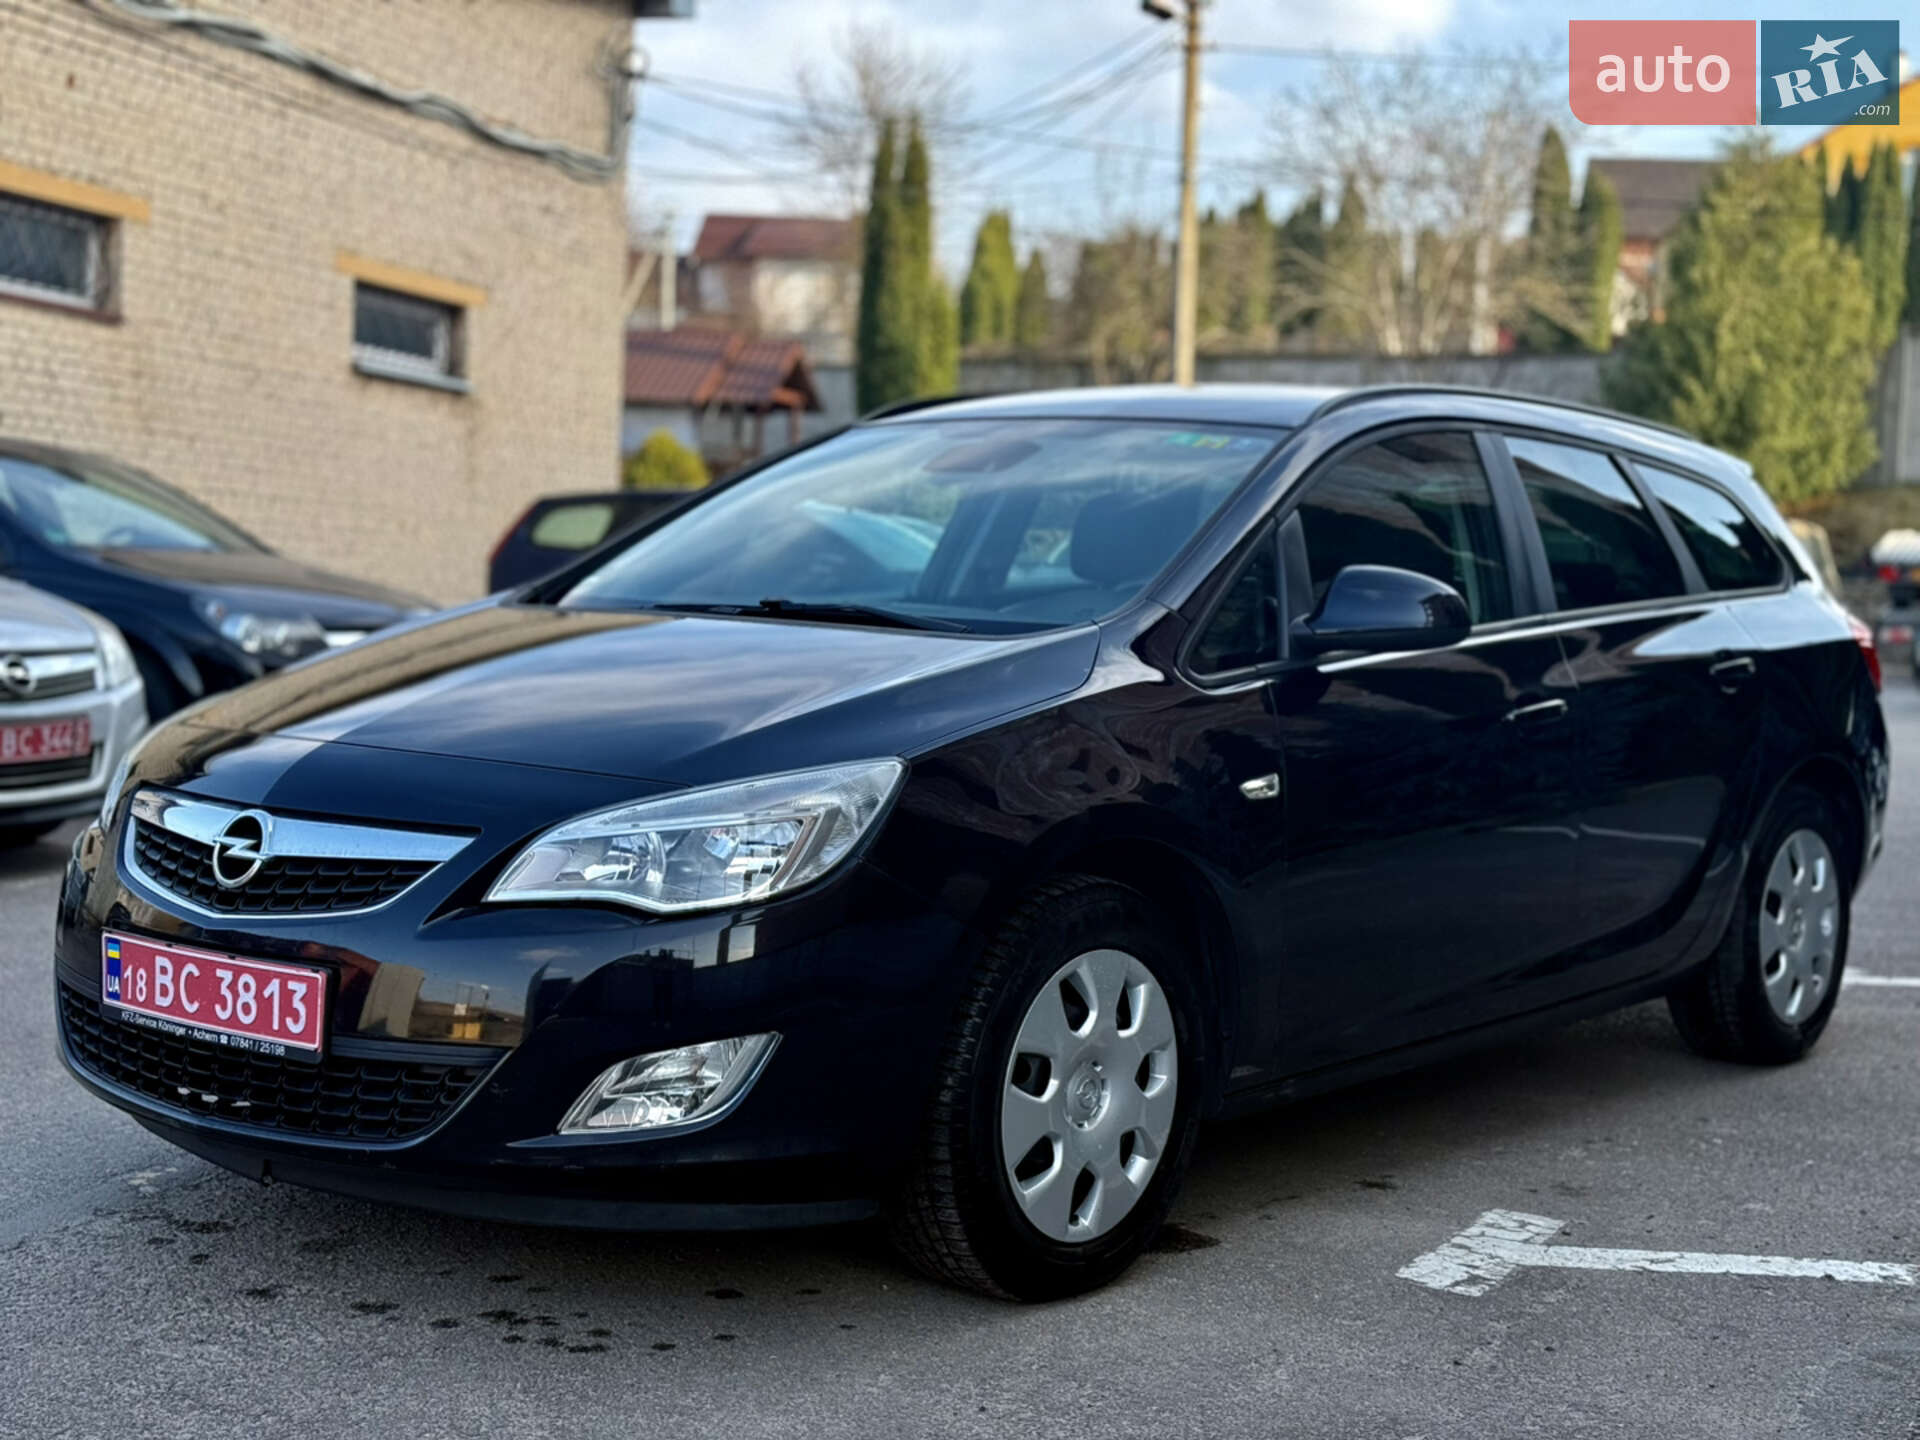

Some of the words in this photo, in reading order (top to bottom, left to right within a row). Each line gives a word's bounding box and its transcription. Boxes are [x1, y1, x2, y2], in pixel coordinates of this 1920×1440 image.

[108, 975, 120, 993] UA
[124, 965, 147, 1002] 18
[155, 955, 200, 1013] BC
[214, 968, 307, 1034] 3813
[230, 1035, 254, 1052] 07841
[260, 1042, 286, 1056] 25198
